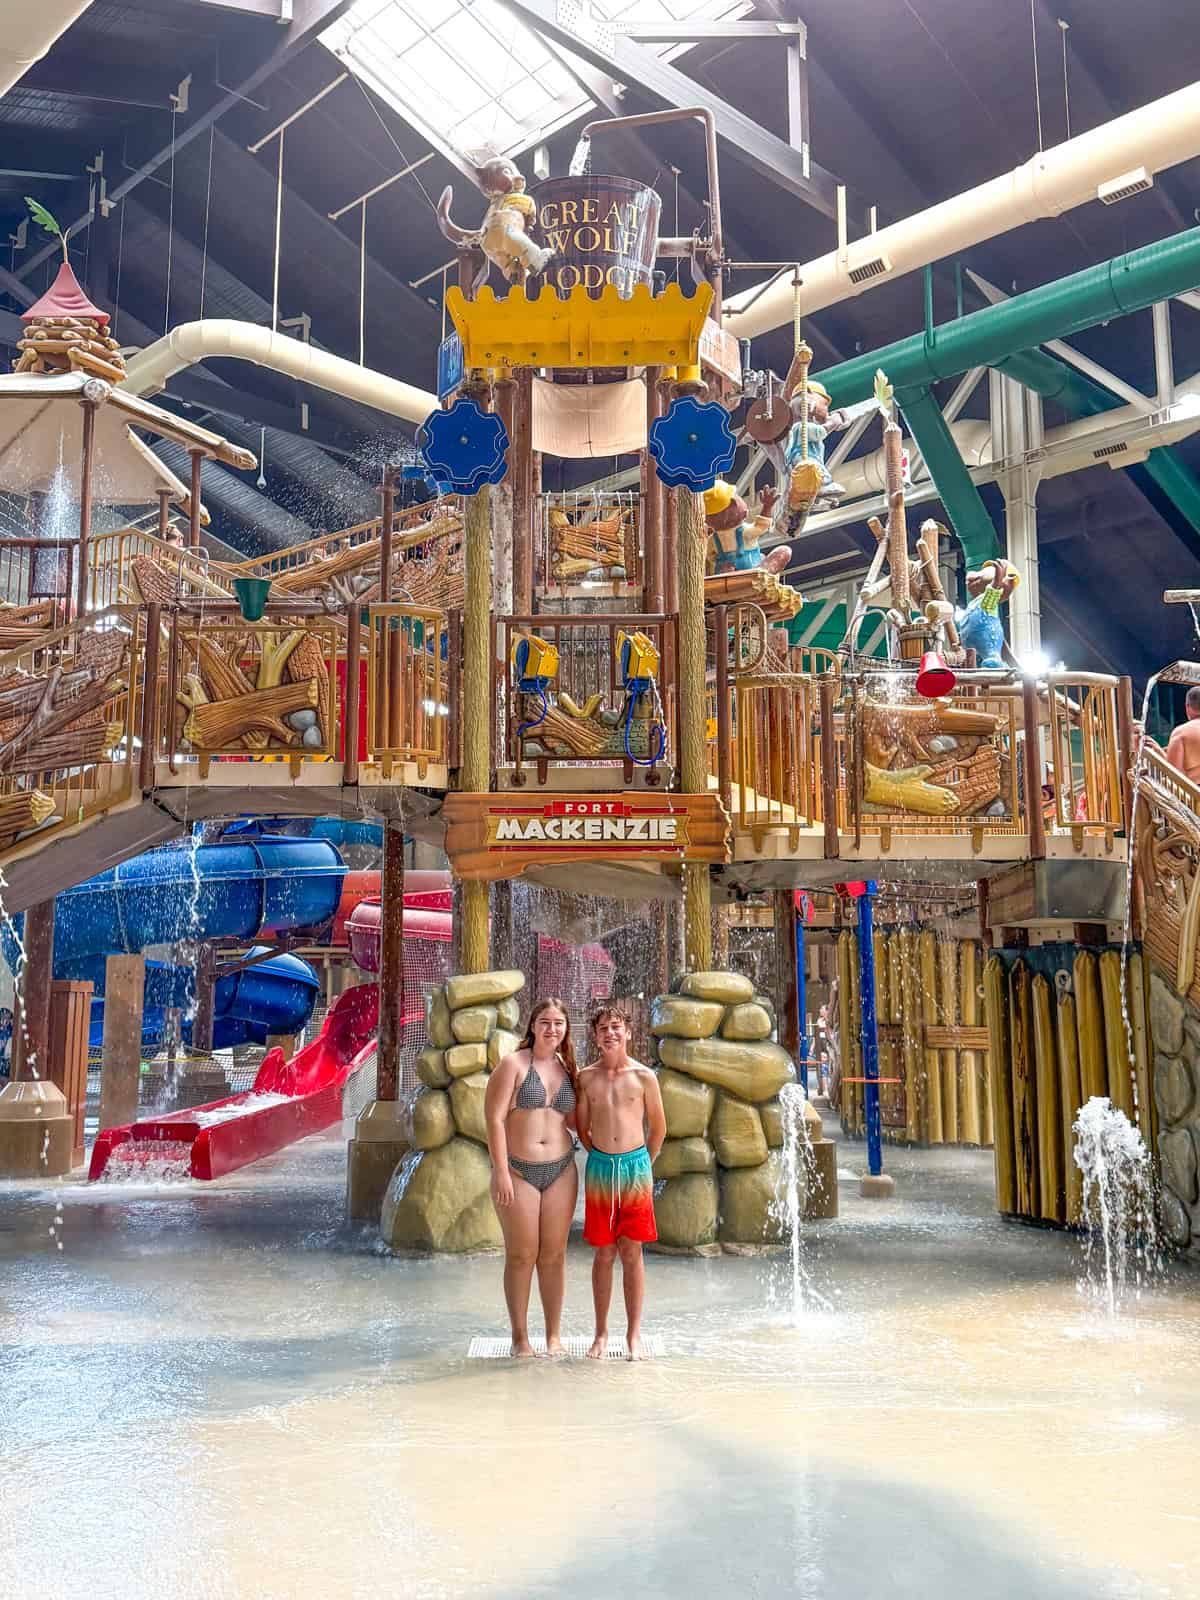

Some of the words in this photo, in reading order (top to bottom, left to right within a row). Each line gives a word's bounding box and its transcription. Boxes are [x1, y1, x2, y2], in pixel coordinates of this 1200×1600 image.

[540, 198, 642, 230] GREAT
[544, 226, 638, 255] WOLF
[564, 803, 615, 813] FORT
[495, 818, 677, 840] MACKENZIE
